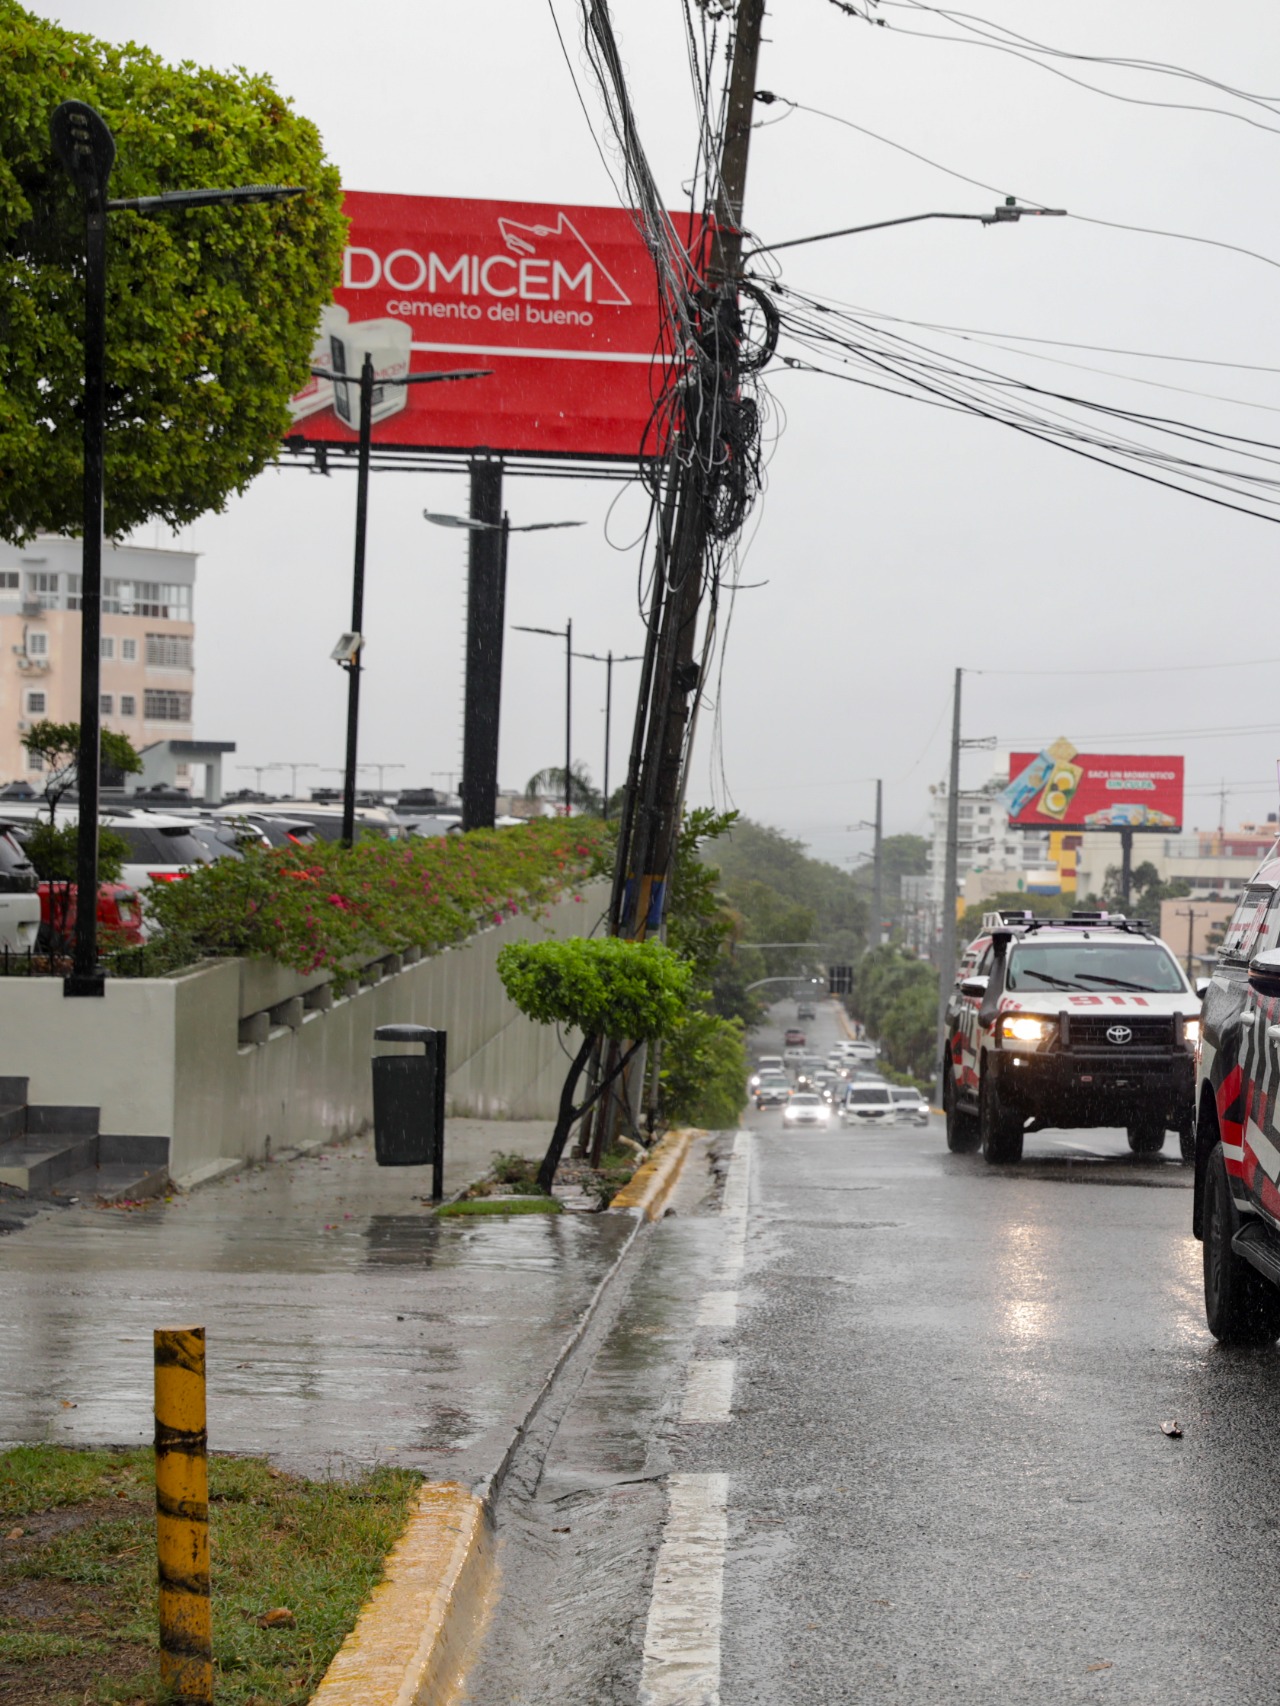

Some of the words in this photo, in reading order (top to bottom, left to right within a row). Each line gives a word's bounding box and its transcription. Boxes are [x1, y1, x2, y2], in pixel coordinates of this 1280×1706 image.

[342, 246, 593, 302] DOMICEM
[385, 299, 482, 320] cemento
[487, 304, 520, 322] del
[526, 305, 593, 326] bueno
[1068, 996, 1150, 1007] 911
